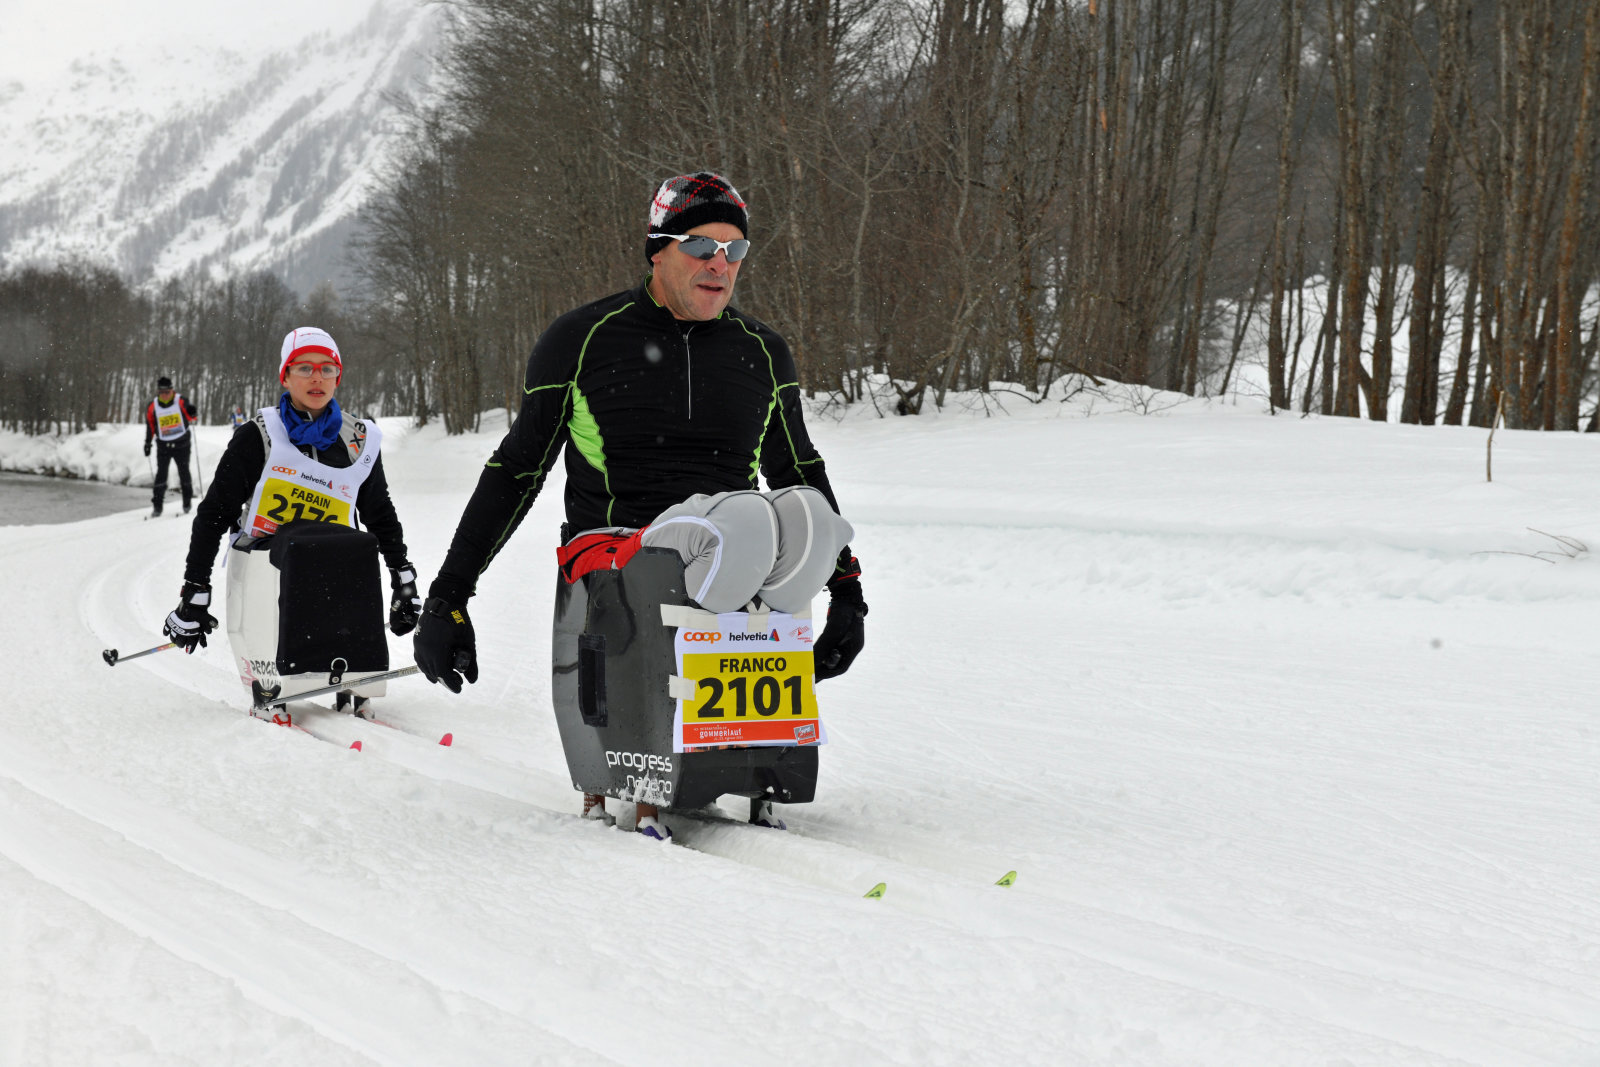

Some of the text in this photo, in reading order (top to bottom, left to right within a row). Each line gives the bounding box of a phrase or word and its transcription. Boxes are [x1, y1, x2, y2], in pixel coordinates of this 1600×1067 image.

[271, 465, 297, 476] coop
[300, 472, 327, 486] helvetia
[290, 487, 331, 509] FABAIN
[683, 631, 722, 644] coop
[729, 631, 768, 641] helvetia
[719, 657, 787, 673] FRANCO
[697, 675, 802, 718] 2101
[605, 750, 673, 773] progress
